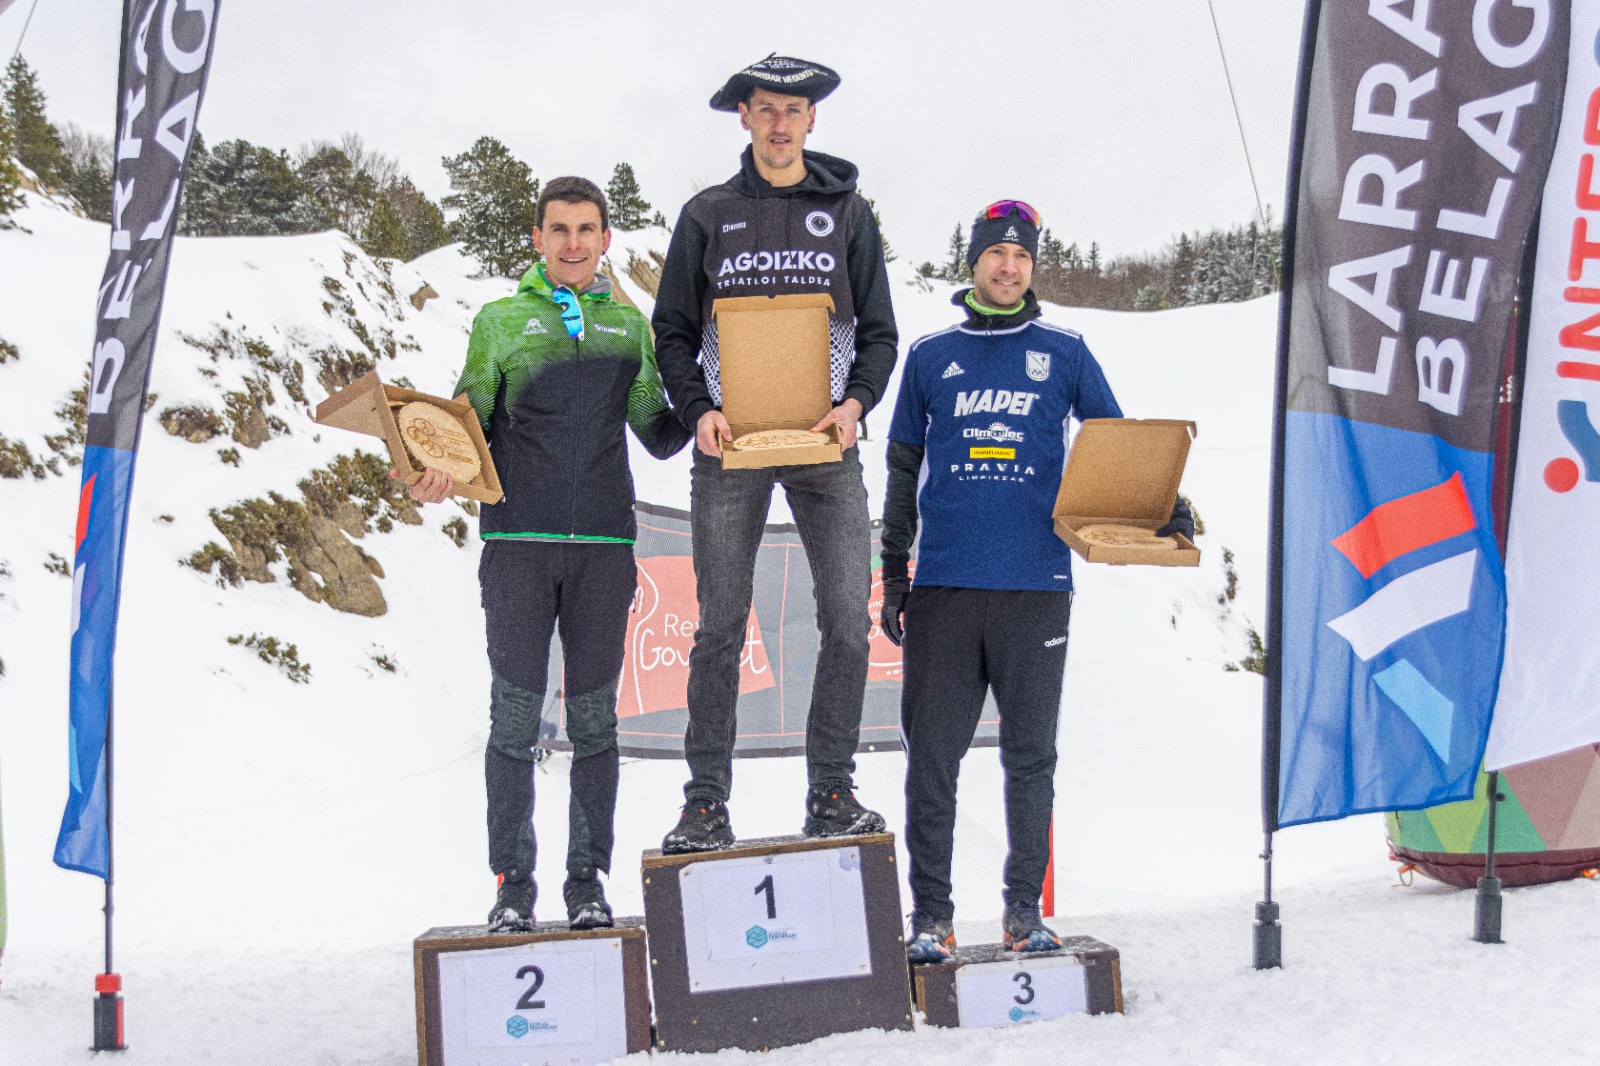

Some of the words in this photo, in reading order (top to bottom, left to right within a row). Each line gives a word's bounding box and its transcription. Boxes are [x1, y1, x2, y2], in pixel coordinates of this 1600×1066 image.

[718, 250, 836, 277] AGOIZKO
[717, 276, 776, 290] TRIATLOI
[783, 275, 831, 287] TALDEA
[950, 462, 1036, 475] PRAVIA
[1044, 635, 1067, 647] adidas
[754, 874, 777, 919] 1
[514, 964, 546, 1010] 2
[1012, 971, 1035, 1005] 3
